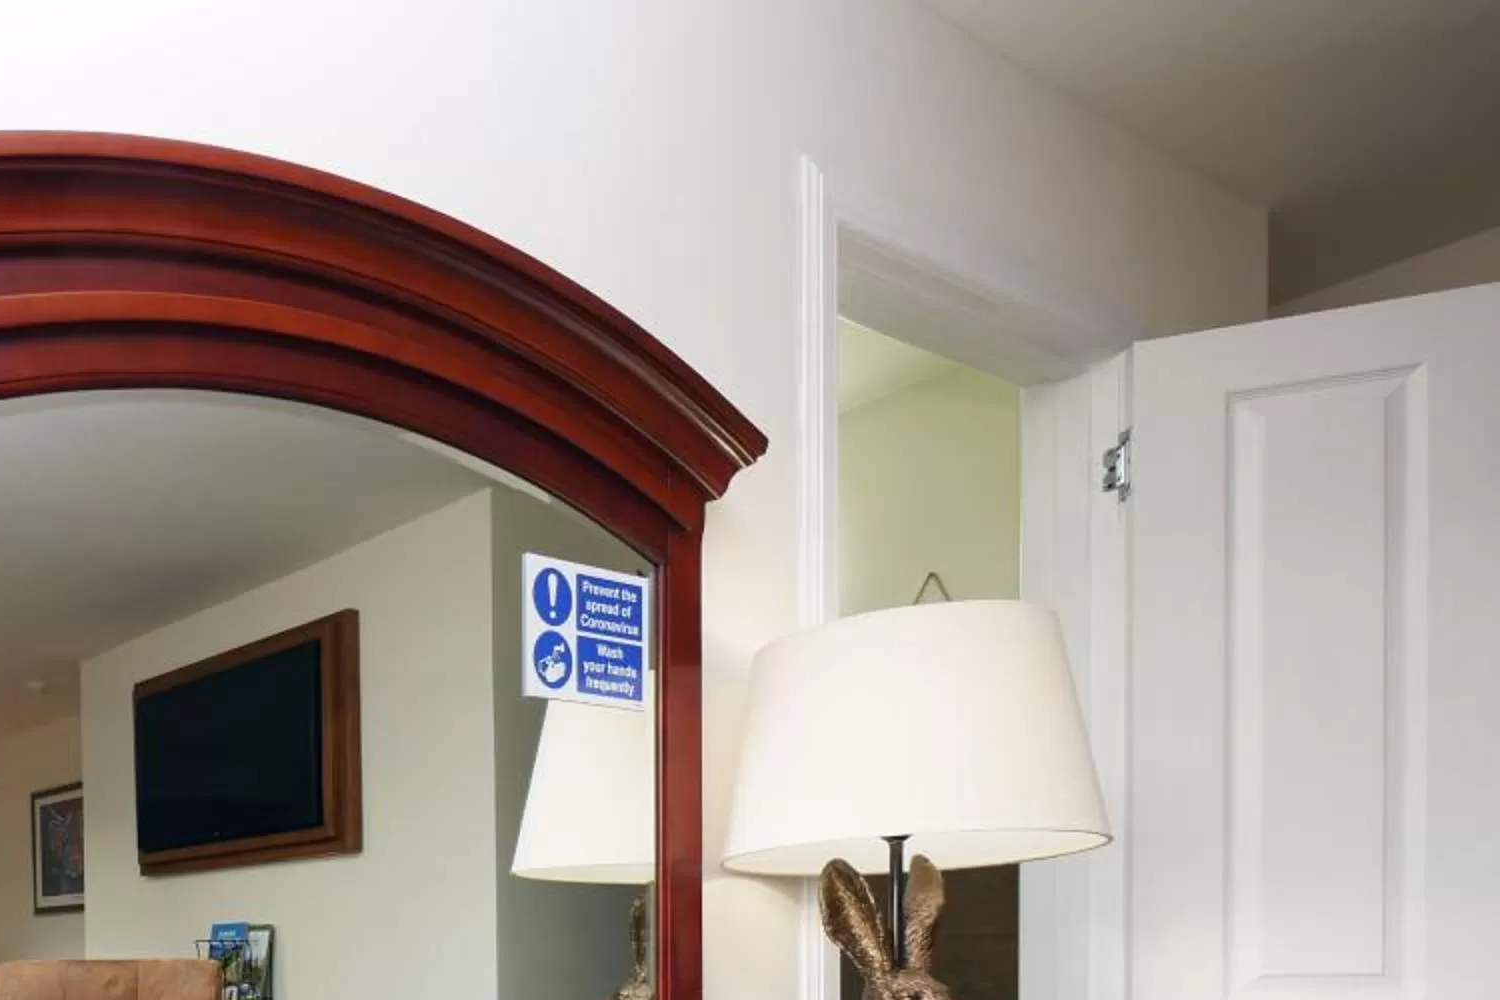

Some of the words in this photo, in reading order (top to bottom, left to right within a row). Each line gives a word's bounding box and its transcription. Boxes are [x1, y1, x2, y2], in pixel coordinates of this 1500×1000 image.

[581, 580, 620, 599] Prevent
[621, 586, 637, 603] the
[585, 601, 619, 616] spread
[621, 604, 632, 618] of
[580, 613, 639, 635] Coronavirus
[596, 643, 624, 660] Wash
[583, 661, 606, 675] your
[607, 661, 637, 679] hands
[586, 677, 636, 697] frequently
